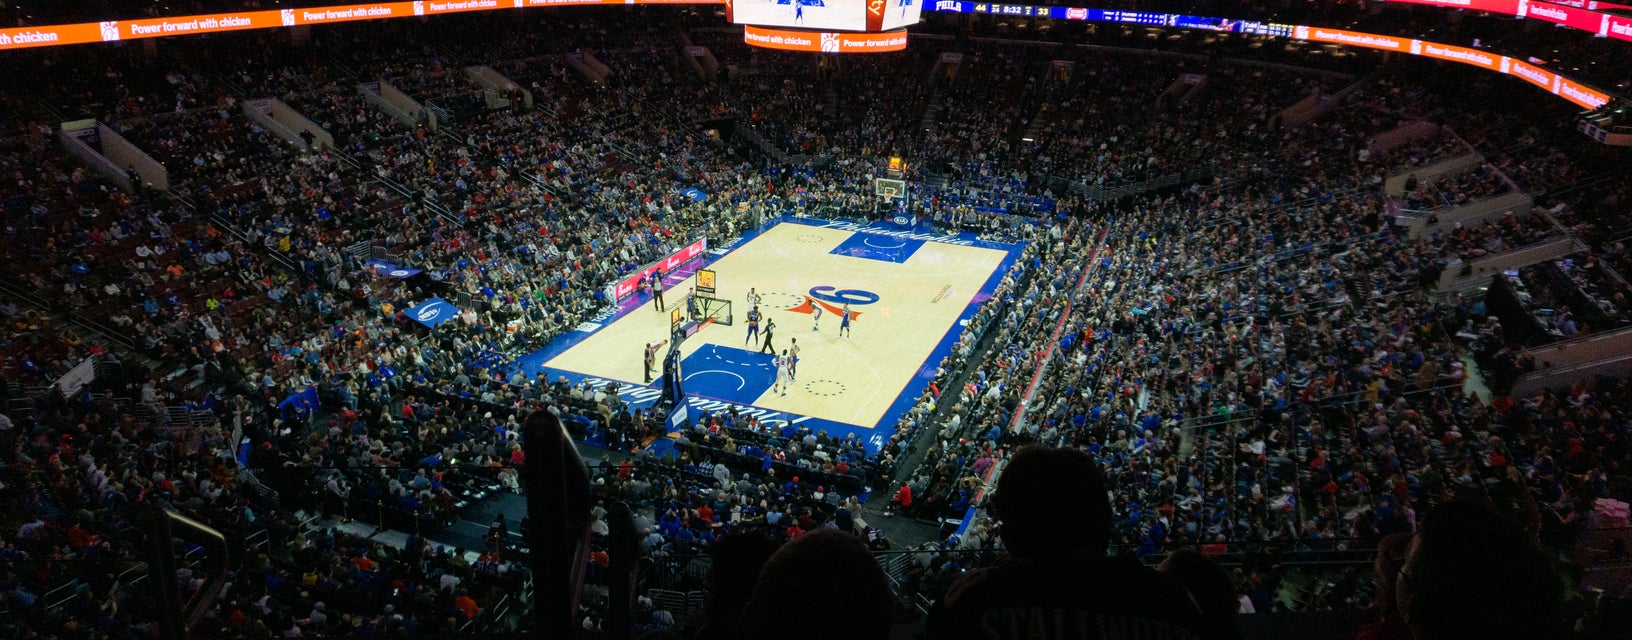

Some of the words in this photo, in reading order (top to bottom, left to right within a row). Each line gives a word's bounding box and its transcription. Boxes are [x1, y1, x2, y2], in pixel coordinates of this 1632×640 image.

[430, 3, 446, 11] Power
[1003, 6, 1021, 14] 8:32
[303, 12, 325, 20] Power
[327, 9, 352, 18] forward
[353, 8, 367, 16] with
[368, 7, 391, 15] chicken
[131, 24, 161, 34] Power
[163, 20, 198, 31] forward
[199, 18, 218, 28] with
[219, 17, 251, 27] chicken
[13, 31, 58, 43] chicken
[770, 36, 783, 44] with
[784, 37, 811, 46] chicken
[844, 39, 865, 47] Power
